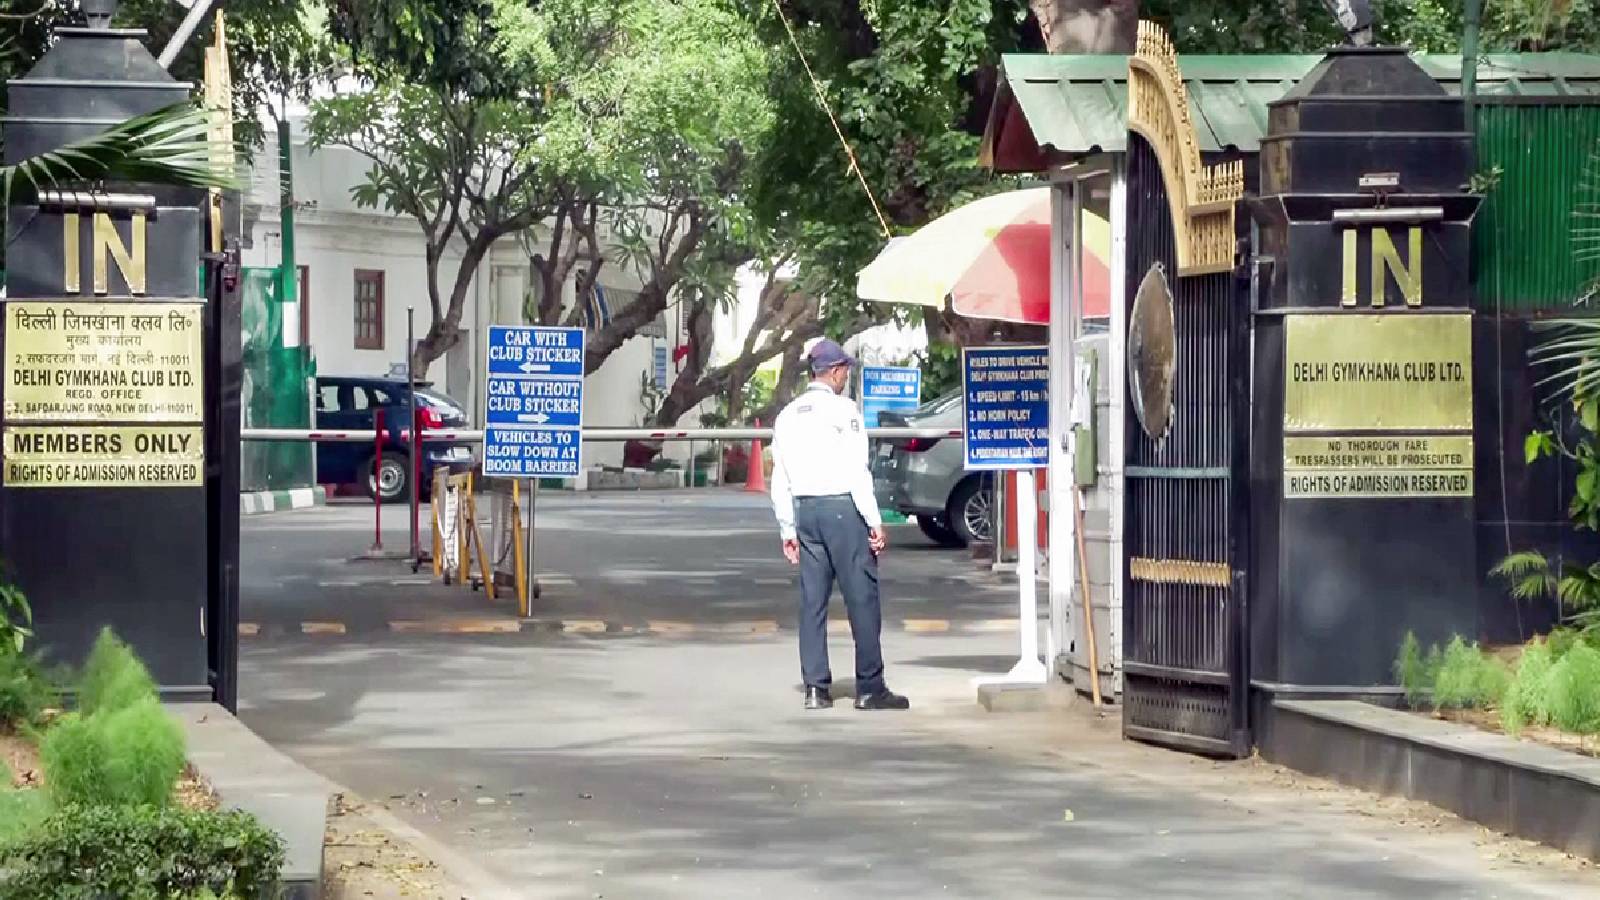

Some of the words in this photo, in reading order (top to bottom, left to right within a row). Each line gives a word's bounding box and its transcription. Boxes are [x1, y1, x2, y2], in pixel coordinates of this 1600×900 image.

[64, 212, 146, 293] IN
[1342, 227, 1422, 306] IN
[15, 307, 57, 330] दिल्ली
[505, 330, 531, 346] CAR
[534, 332, 567, 347] WITH
[490, 346, 523, 362] CLUB
[526, 346, 580, 363] STICKER
[13, 369, 51, 387] DELHI
[55, 369, 128, 387] GYMKHANA
[131, 370, 165, 387] CLUB
[168, 370, 194, 387] LTD.
[1293, 362, 1328, 382] DELHI
[1332, 362, 1400, 382] GYMKHANA
[1404, 362, 1436, 382] CLUB
[1439, 362, 1465, 382] LTD.
[100, 389, 142, 399] OFFICE
[489, 380, 515, 395] CAR
[519, 381, 580, 397] WITHOUT
[26, 402, 85, 414] SAFDARJUNG
[115, 402, 136, 414] NEW
[488, 397, 521, 412] CLUB
[524, 398, 579, 414] STICKER
[14, 433, 122, 453] MEMBERS
[134, 433, 192, 453] ONLY
[493, 430, 552, 444] VEHICLES
[555, 432, 572, 444] TO
[487, 445, 520, 457] SLOW
[524, 446, 559, 459] DOWN
[561, 446, 577, 459] AT
[1328, 441, 1341, 452] NO
[1347, 440, 1400, 451] THOROUGH
[1404, 440, 1429, 451] FARE
[486, 459, 522, 472] BOOM
[525, 460, 577, 473] BARRIER
[1294, 455, 1360, 466] TRESPASSERS
[1362, 454, 1384, 466] WILL
[1386, 454, 1398, 465] BE
[1401, 454, 1463, 465] PROSECUTED
[10, 464, 53, 481] RIGHTS
[55, 464, 71, 481] OF
[73, 464, 136, 481] ADMISSION
[138, 464, 197, 481] RESERVED
[1291, 476, 1331, 492] RIGHTS
[1333, 475, 1347, 492] OF
[1350, 475, 1408, 492] ADMISSION
[1411, 475, 1468, 492] RESERVED
